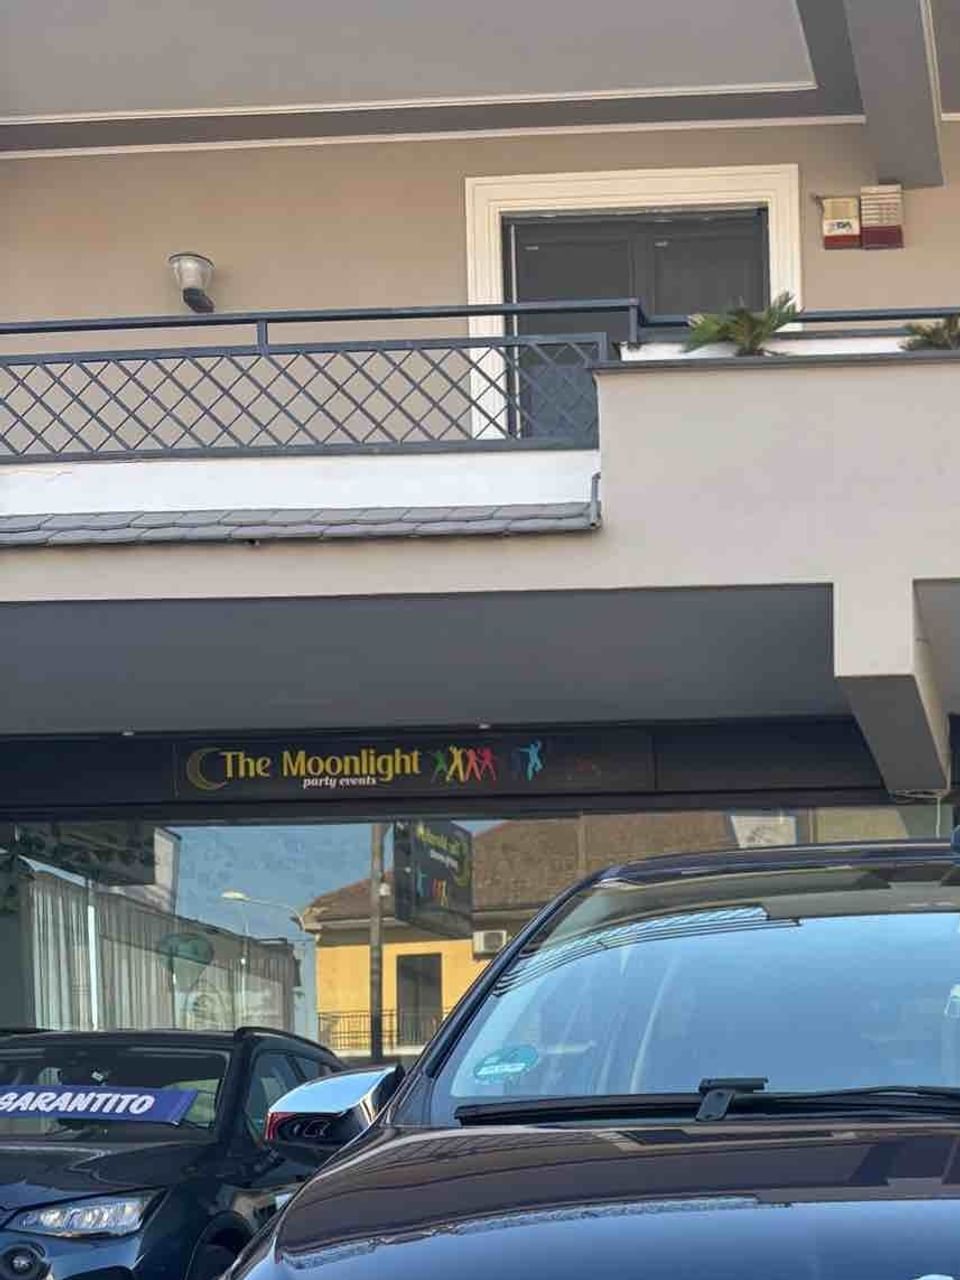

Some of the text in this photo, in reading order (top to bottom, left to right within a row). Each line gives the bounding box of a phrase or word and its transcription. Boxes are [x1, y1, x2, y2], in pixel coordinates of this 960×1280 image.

[221, 748, 421, 781] The Moonlight
[303, 775, 377, 789] party events
